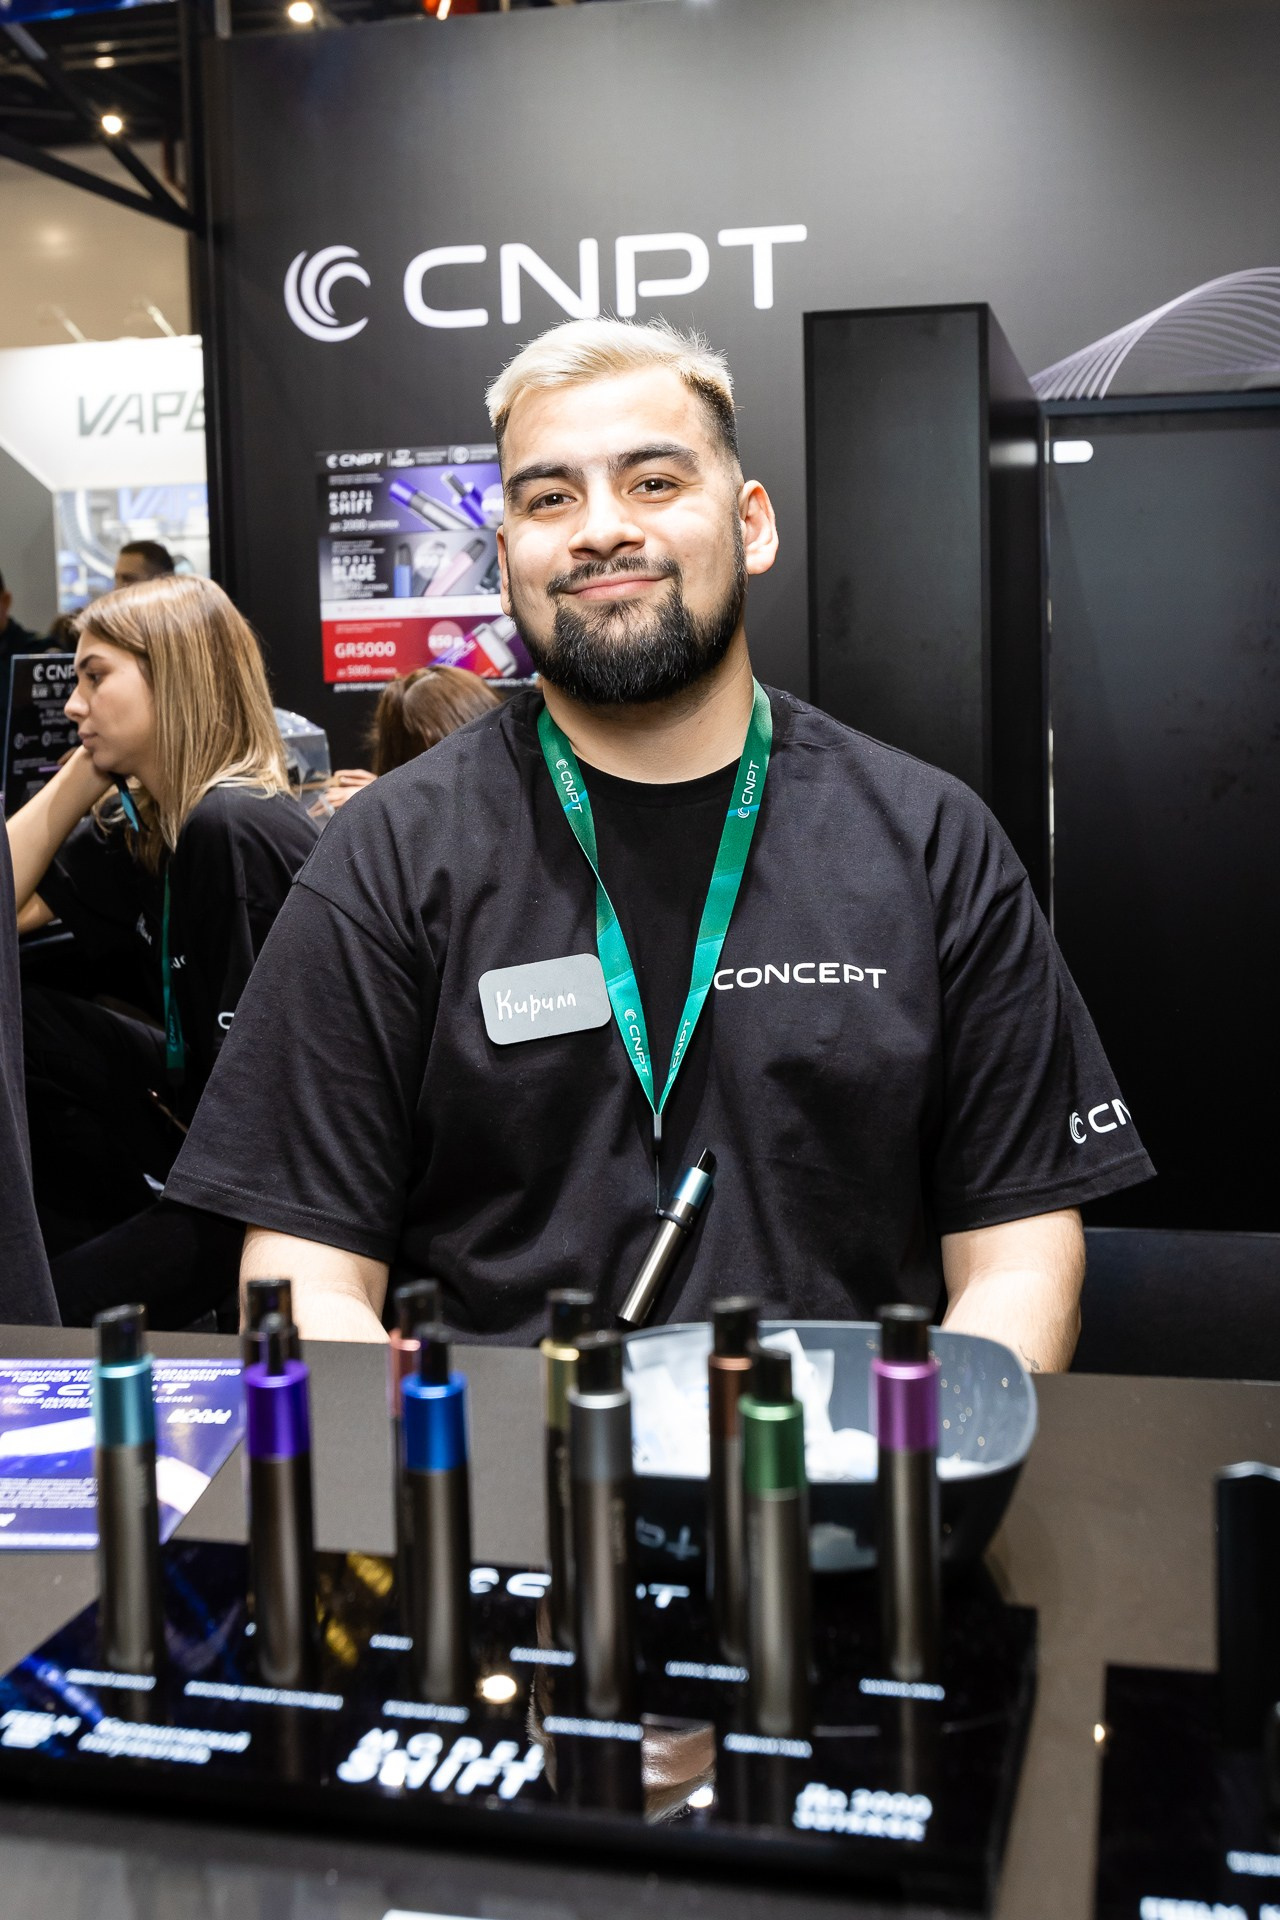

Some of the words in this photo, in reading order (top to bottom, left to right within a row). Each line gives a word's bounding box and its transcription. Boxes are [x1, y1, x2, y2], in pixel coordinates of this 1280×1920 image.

[403, 224, 807, 328] CNPT
[339, 452, 384, 468] CNPT
[329, 499, 373, 515] SHIFT
[334, 641, 396, 658] GR5000
[560, 771, 583, 813] CNPT
[741, 760, 760, 805] CNPT
[713, 962, 887, 991] CONCEPT
[496, 989, 577, 1022] Кирилл
[629, 1024, 649, 1077] CNPT
[672, 1018, 691, 1069] CNPT
